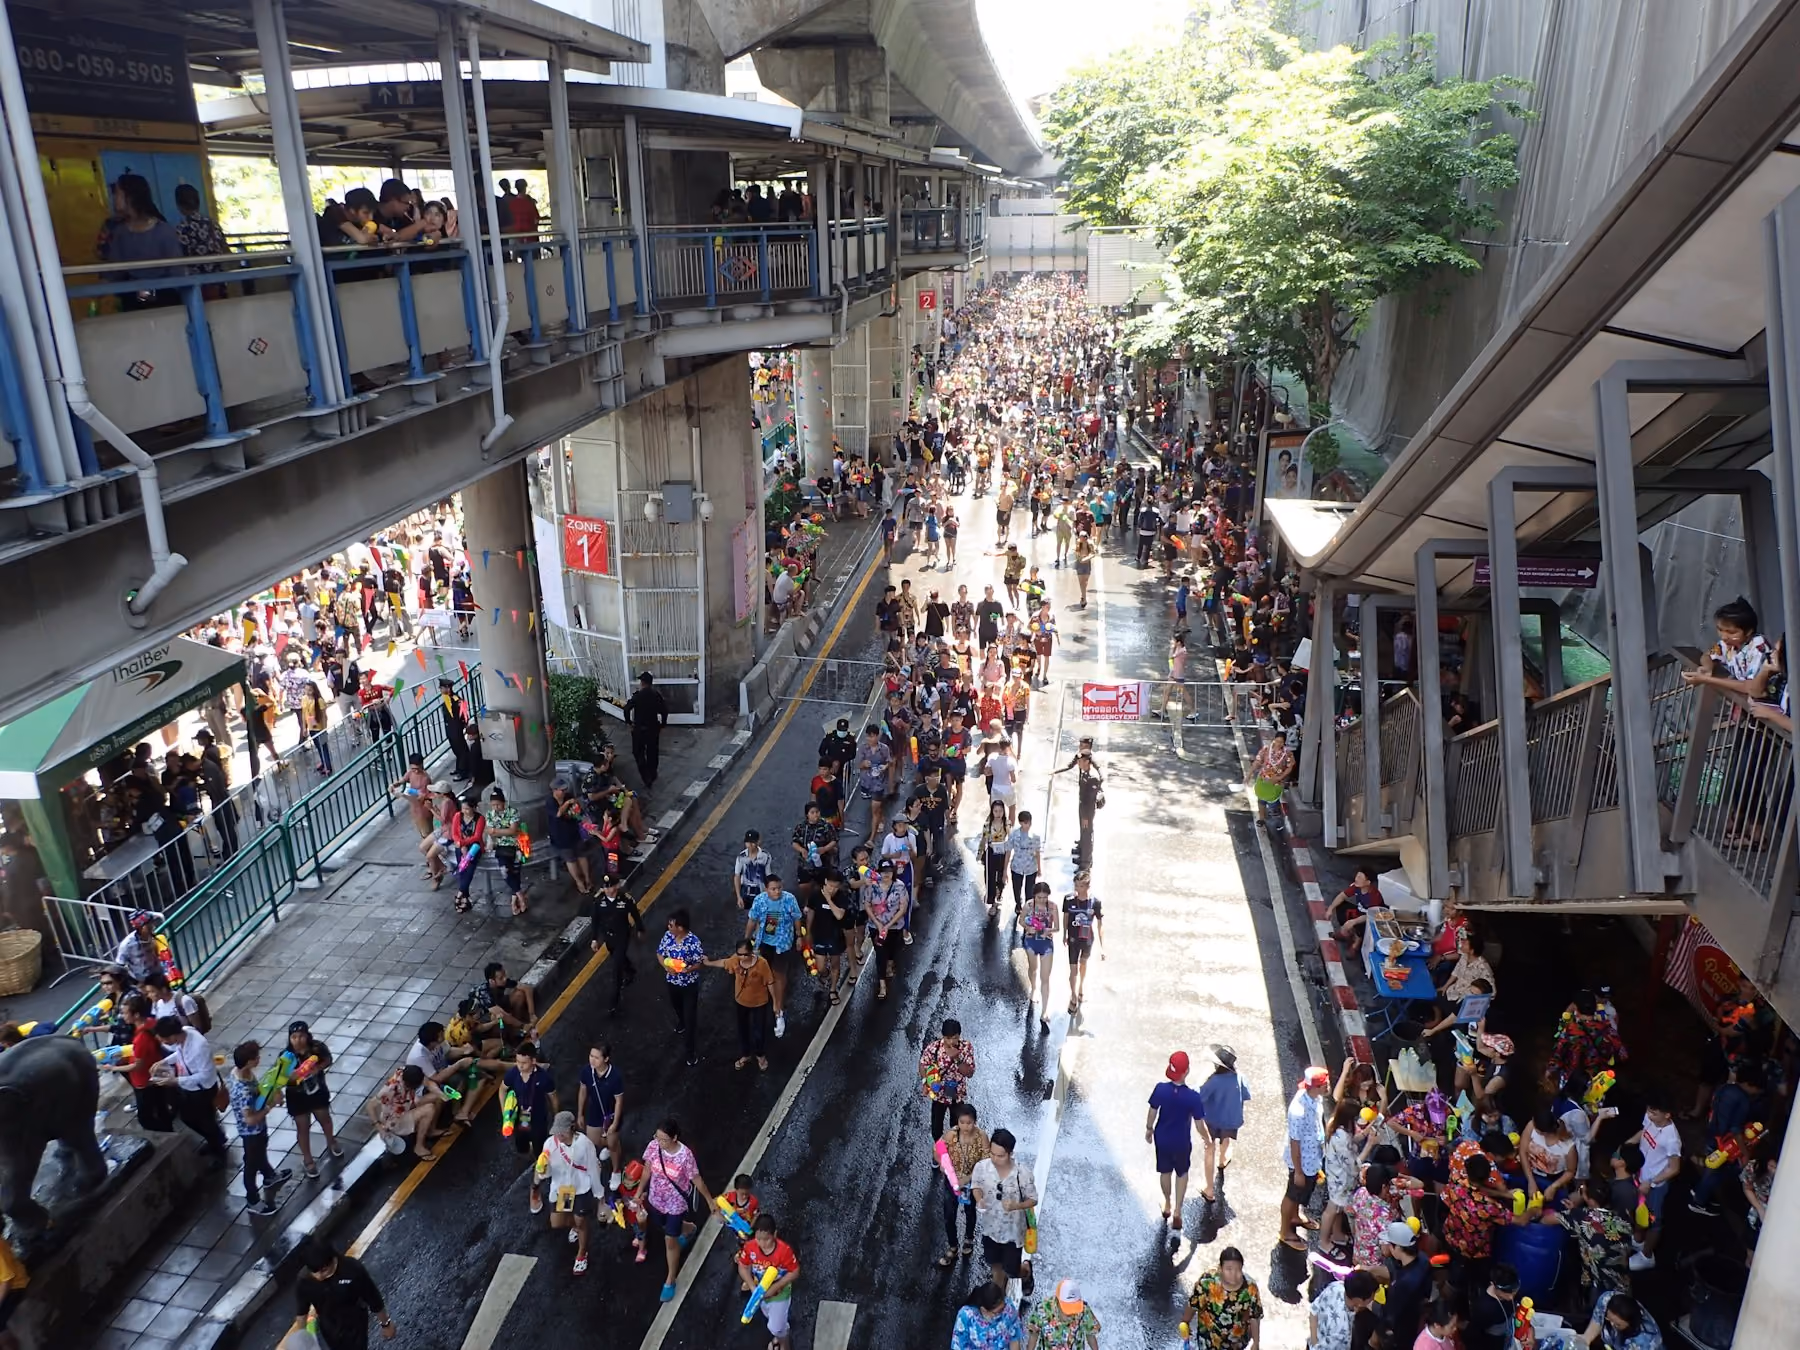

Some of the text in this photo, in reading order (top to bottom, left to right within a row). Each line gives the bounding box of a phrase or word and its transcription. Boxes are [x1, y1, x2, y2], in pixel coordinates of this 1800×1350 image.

[18, 46, 174, 85] 080-059-5905
[923, 295, 931, 308] 2
[567, 518, 603, 534] ZONE
[577, 534, 589, 567] 1
[112, 645, 170, 683] ThaiBev
